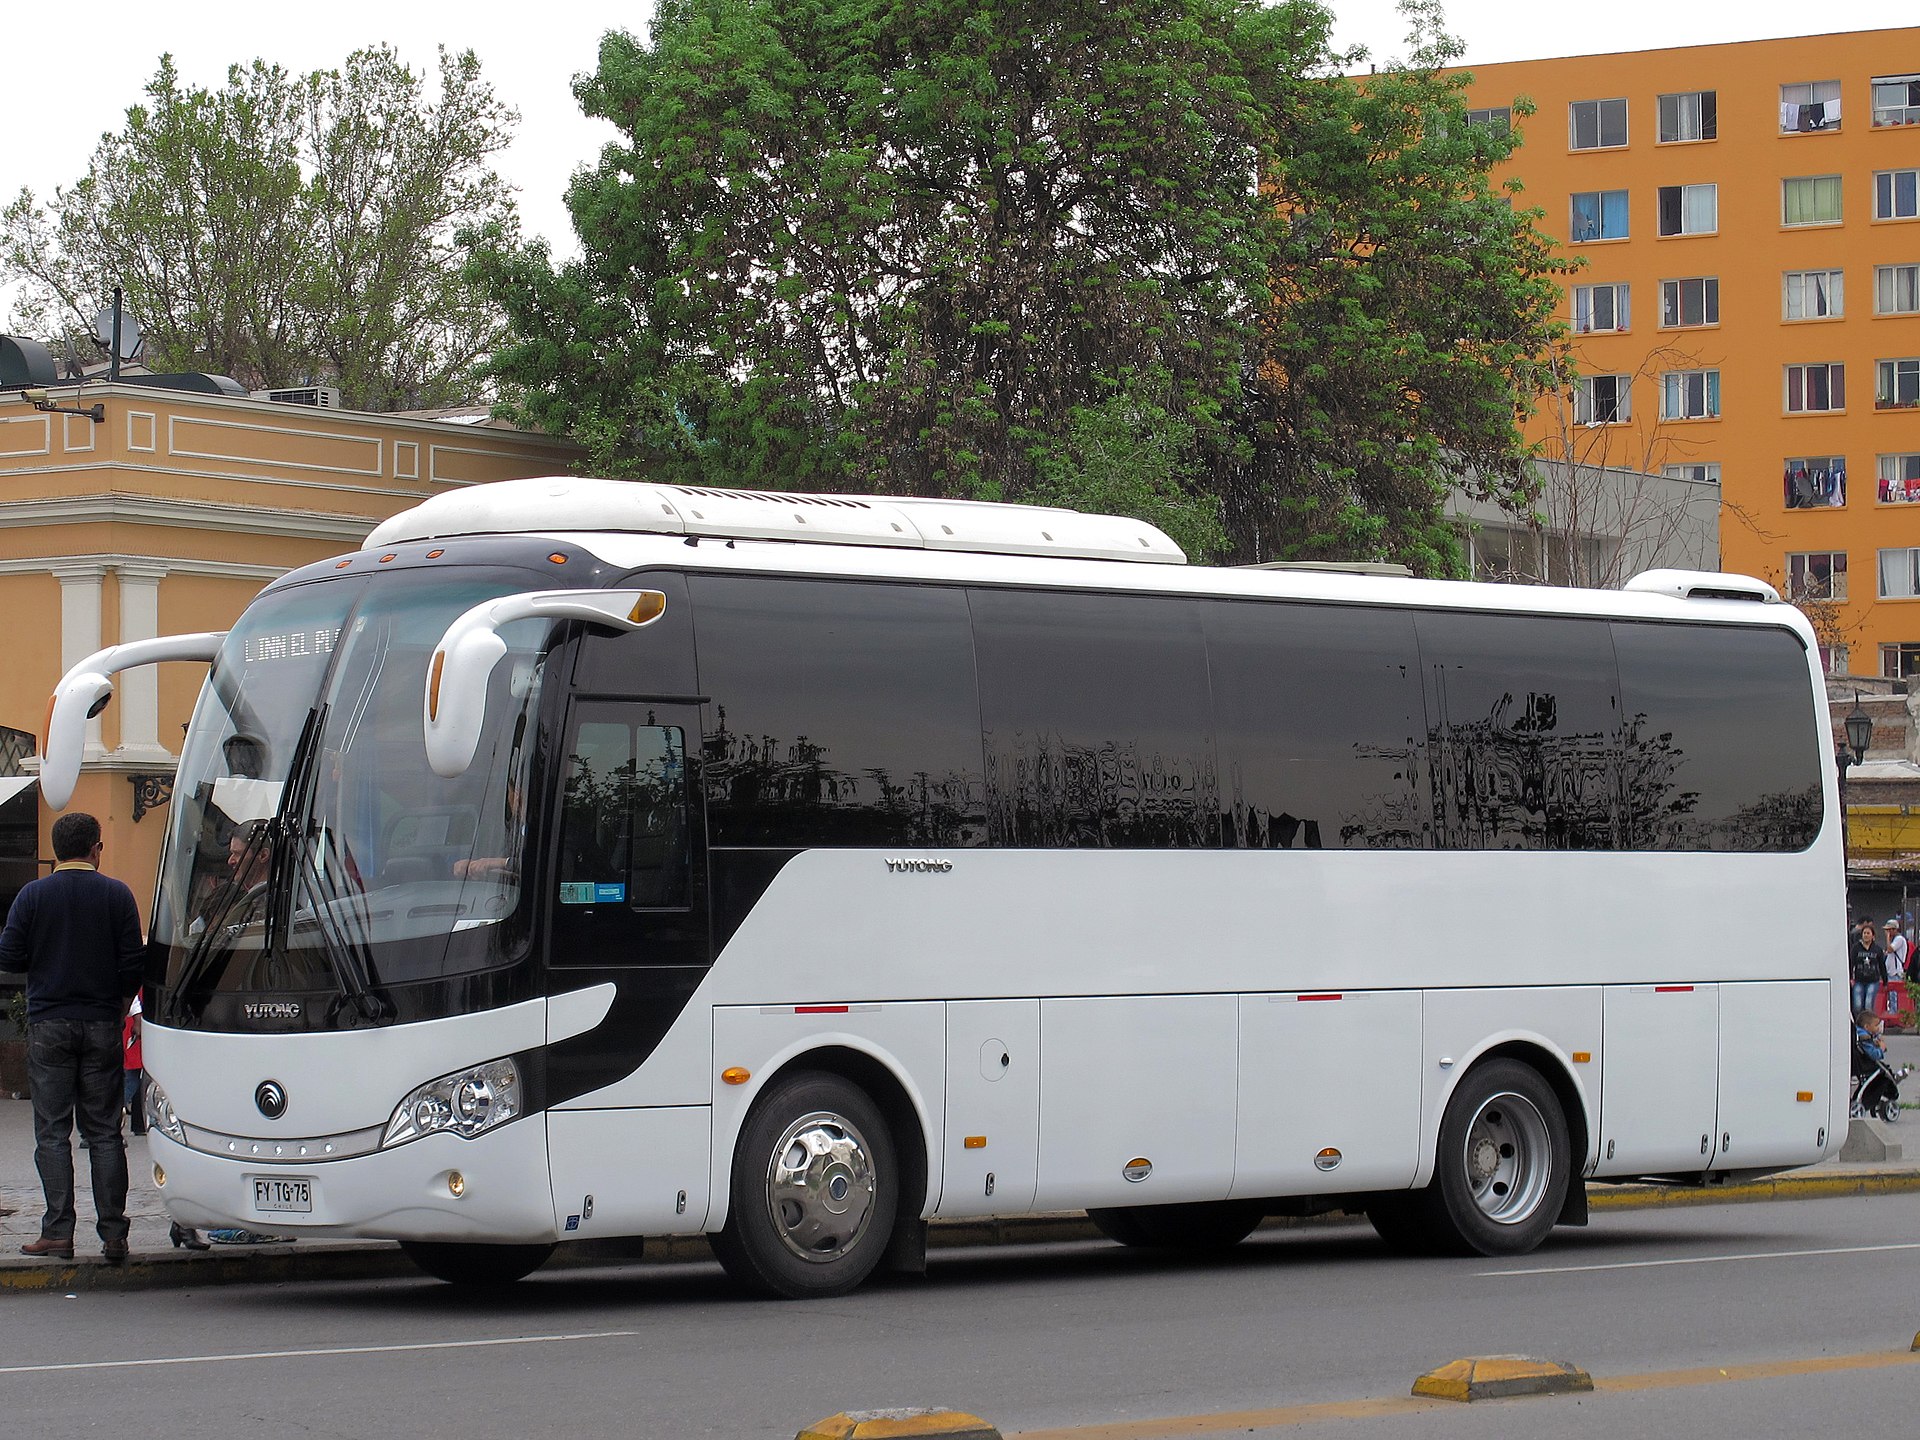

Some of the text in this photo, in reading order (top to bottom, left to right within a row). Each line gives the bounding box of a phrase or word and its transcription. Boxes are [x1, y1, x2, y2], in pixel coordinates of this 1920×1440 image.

[290, 632, 311, 657] EL
[884, 857, 953, 873] YUTONG
[244, 1003, 300, 1019] YUTONG
